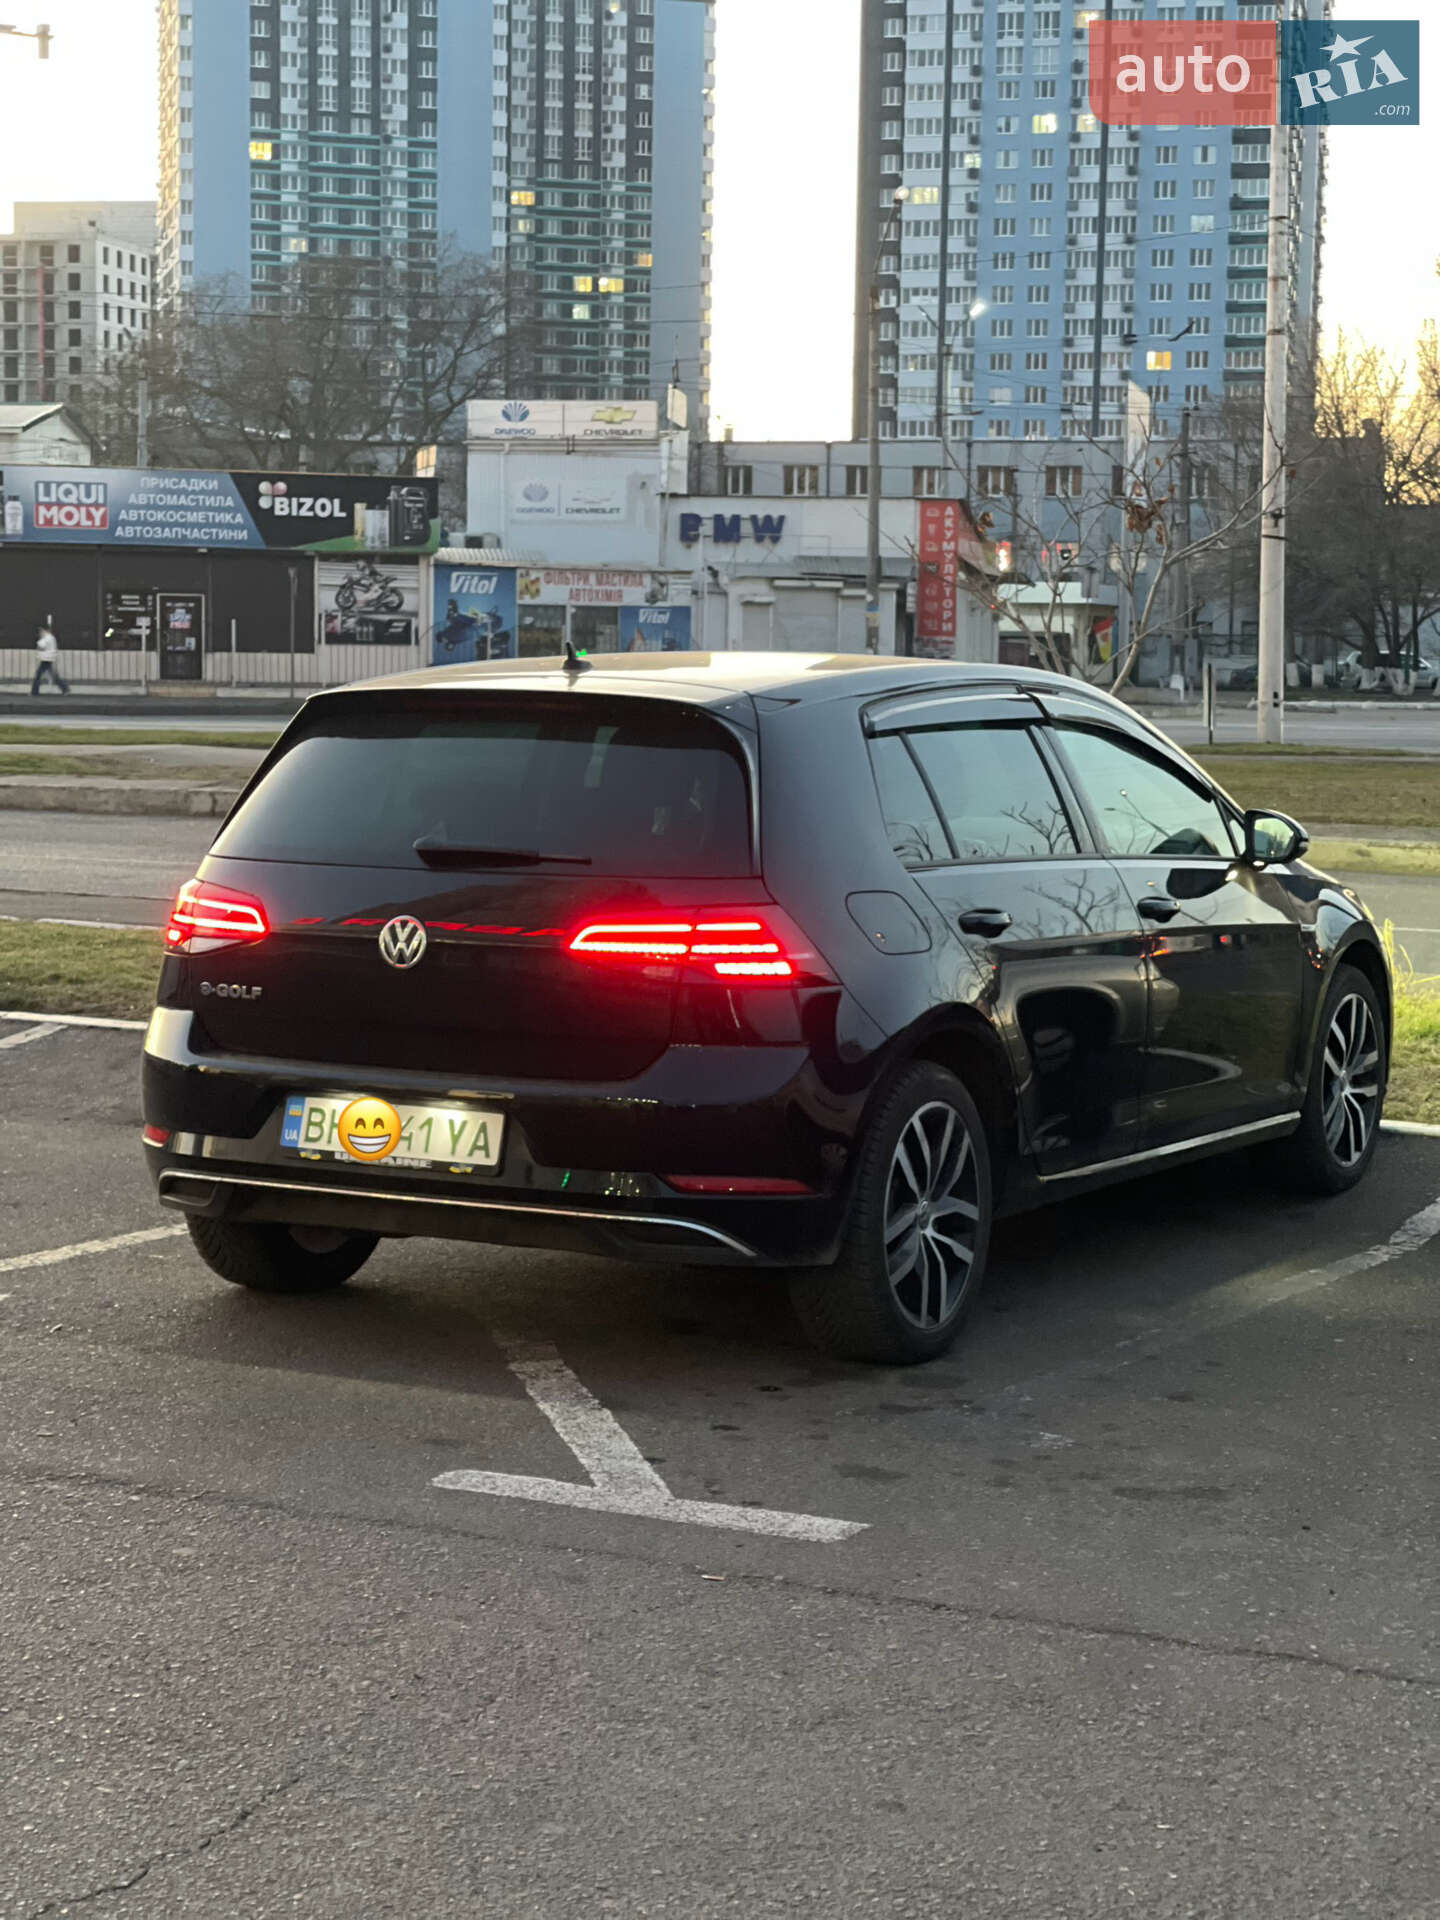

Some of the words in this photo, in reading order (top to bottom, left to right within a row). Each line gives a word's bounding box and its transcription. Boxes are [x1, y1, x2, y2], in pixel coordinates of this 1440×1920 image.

[37, 482, 105, 504] LIQUI
[140, 477, 219, 491] ПРИСАДКИ
[127, 493, 235, 508] АВТОМАСТИЛА
[274, 496, 347, 518] BIZOL
[37, 505, 106, 527] MOLY
[118, 509, 244, 525] АВТОКОСМЕТИКА
[114, 525, 249, 541] АВТОЗАПЧАСТИНИ
[680, 512, 786, 544] BMW
[450, 572, 499, 595] Vitol
[285, 1130, 298, 1141] UA
